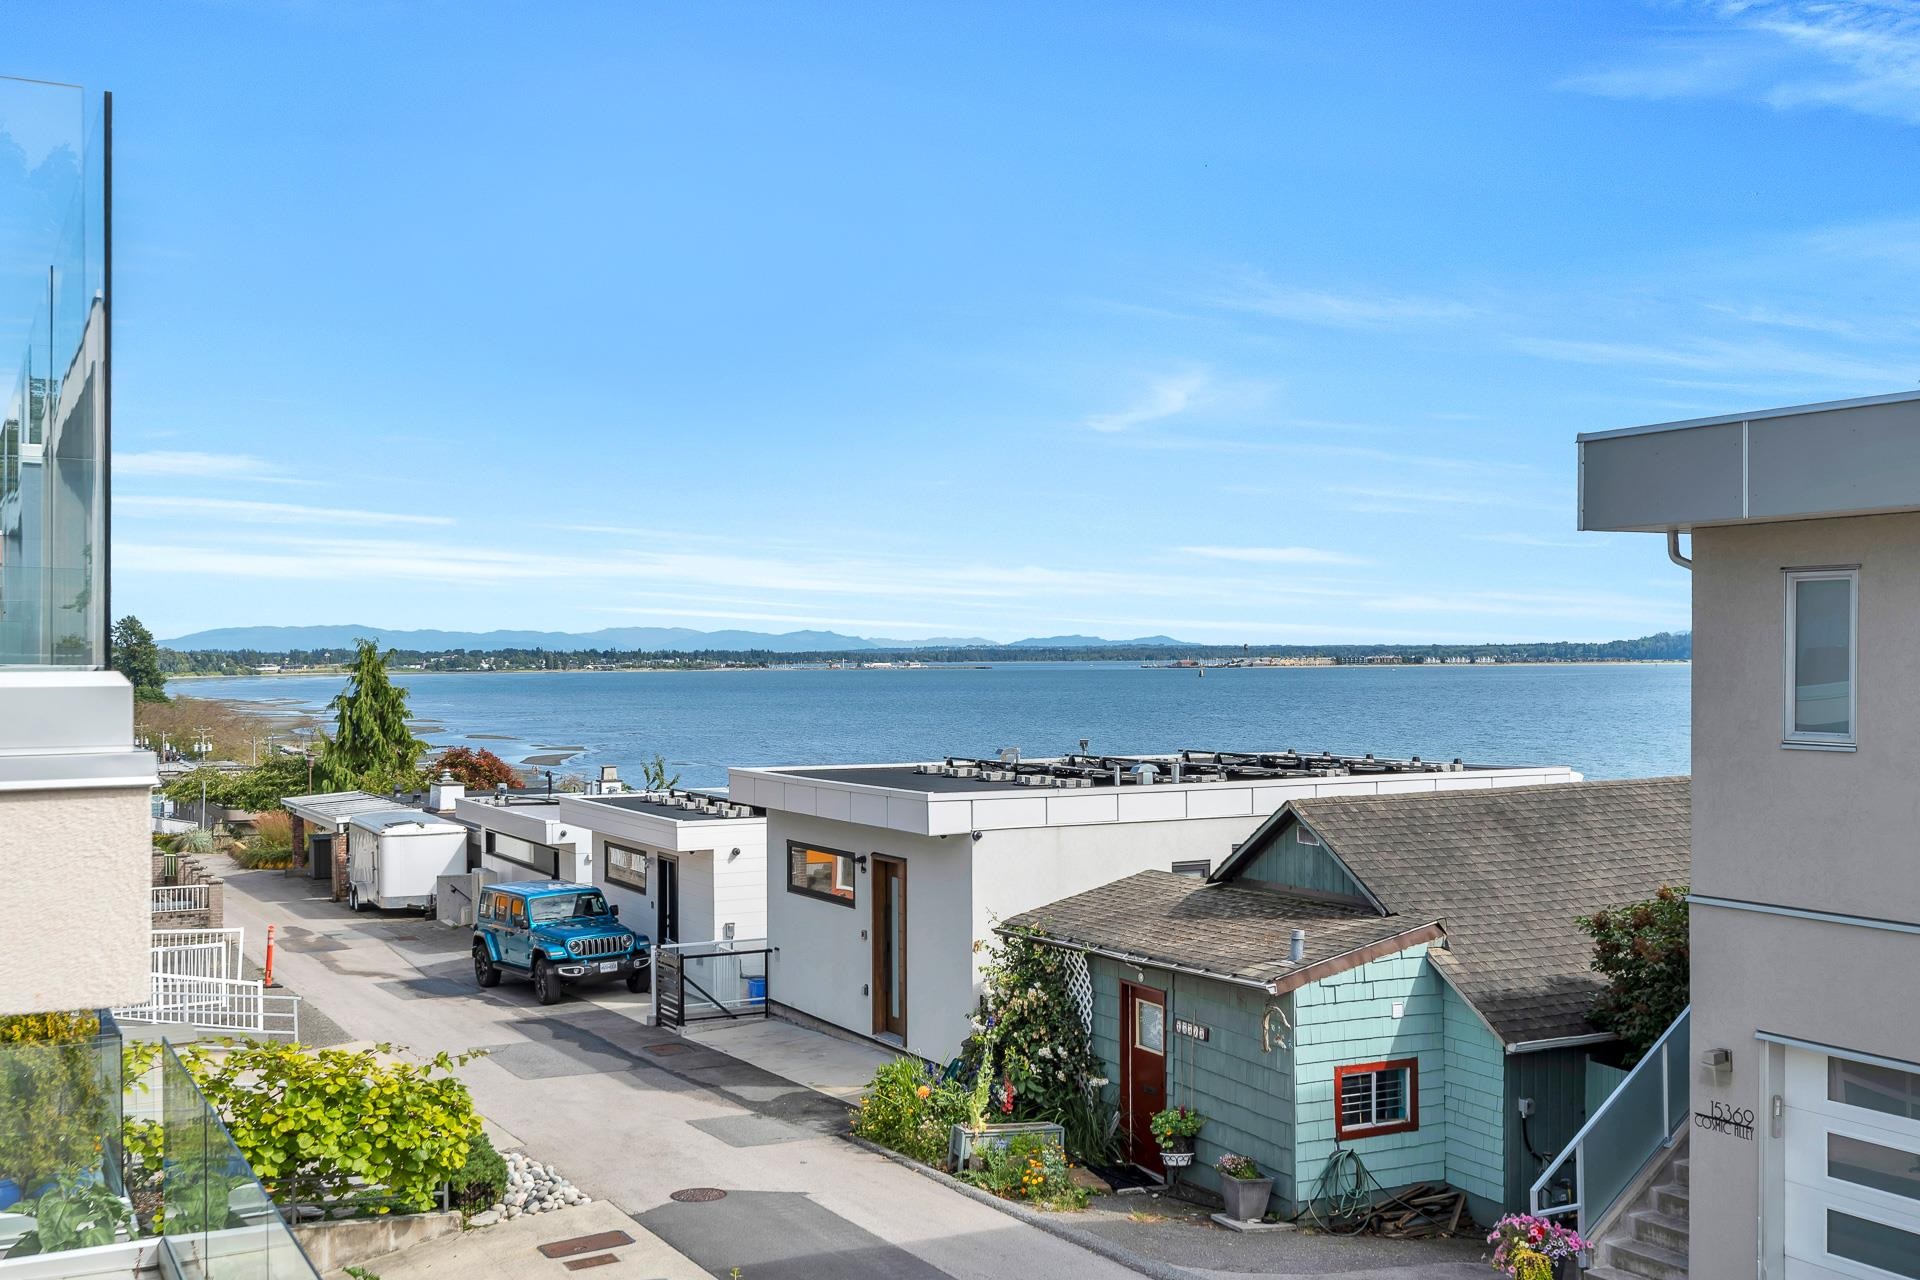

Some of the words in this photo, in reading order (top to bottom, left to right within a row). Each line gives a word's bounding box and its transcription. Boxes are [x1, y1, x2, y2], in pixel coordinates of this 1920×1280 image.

[1694, 1113, 1732, 1135] COSMIC
[1734, 1123, 1754, 1141] ALLEY
[1711, 1100, 1754, 1128] 15369
